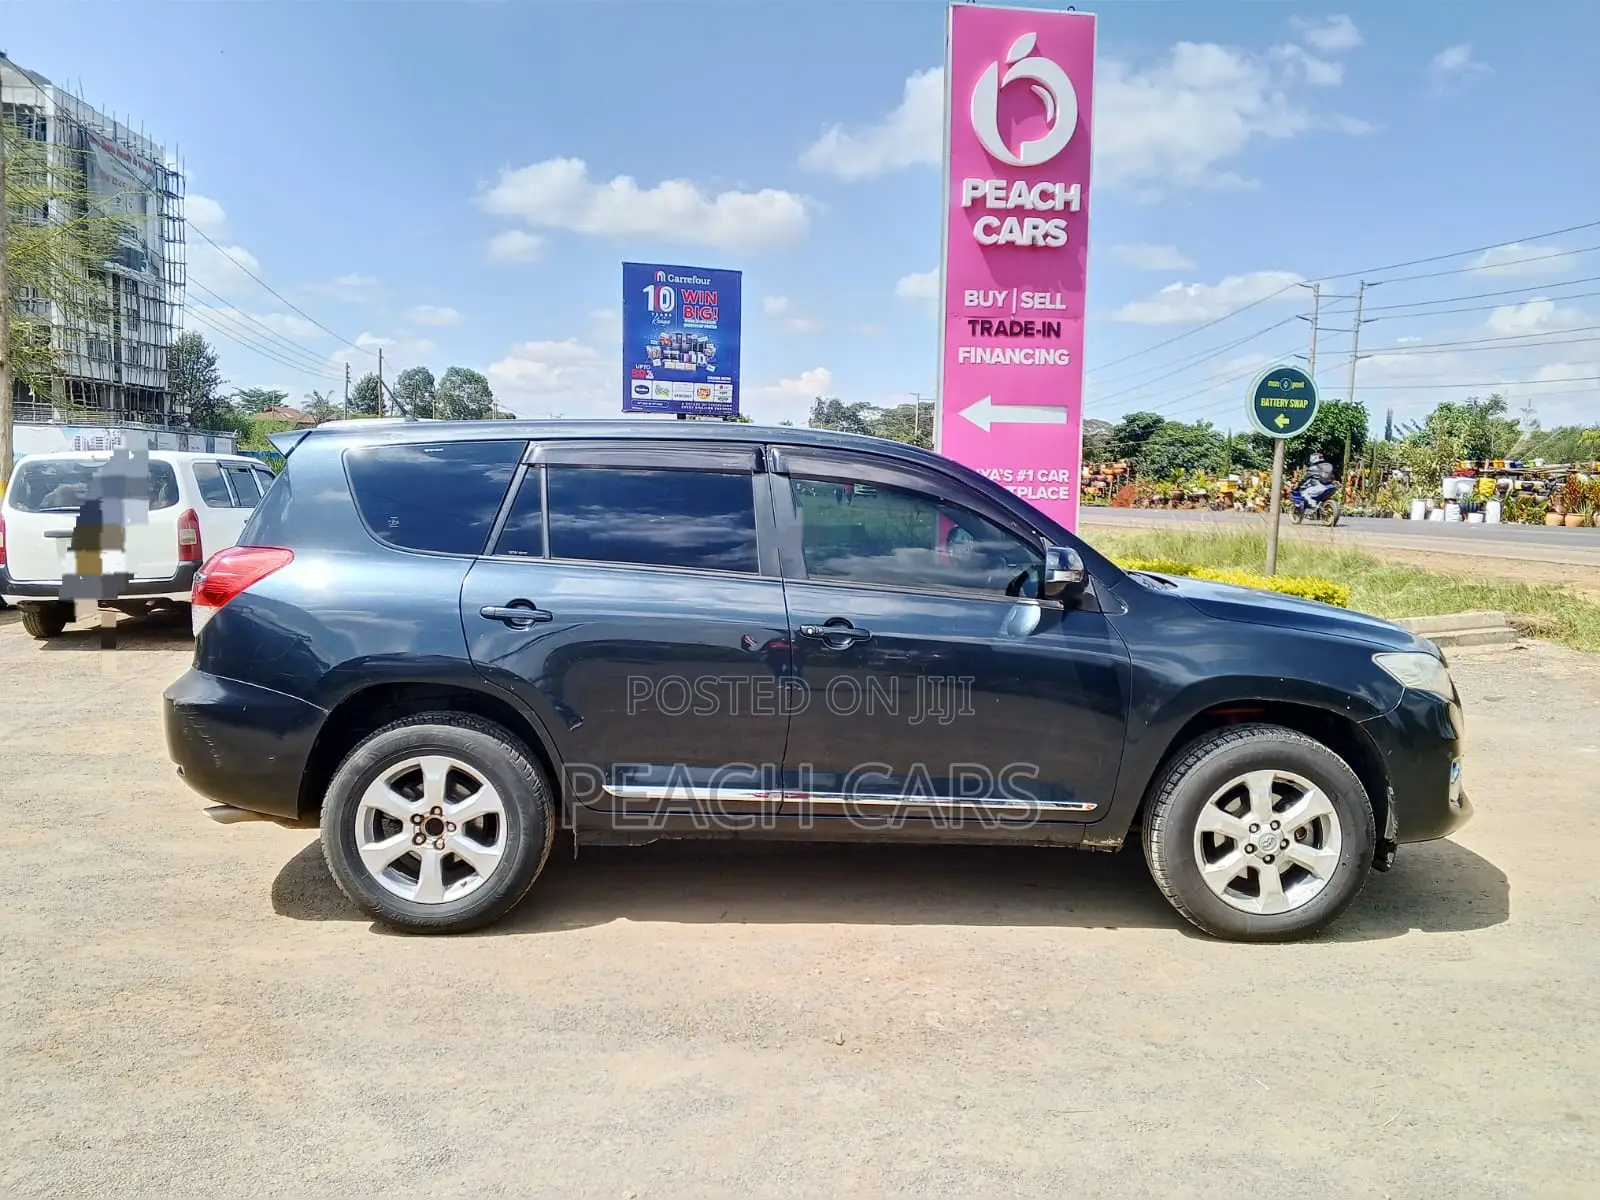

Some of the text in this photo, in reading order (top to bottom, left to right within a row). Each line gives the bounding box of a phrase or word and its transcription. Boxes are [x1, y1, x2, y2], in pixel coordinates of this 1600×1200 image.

[962, 178, 1081, 212] PEACH
[973, 215, 1068, 247] CARS
[668, 275, 711, 285] Carrefour
[643, 285, 674, 312] 10
[681, 289, 717, 304] WIN
[964, 289, 1066, 310] BUY SELL
[684, 305, 718, 319] BIG!
[968, 319, 1061, 338] TRADE-IN
[958, 347, 1070, 366] FINANCING
[1261, 398, 1309, 409] BATTERY SWAP
[1016, 469, 1034, 482] #1
[1037, 469, 1070, 483] CAR
